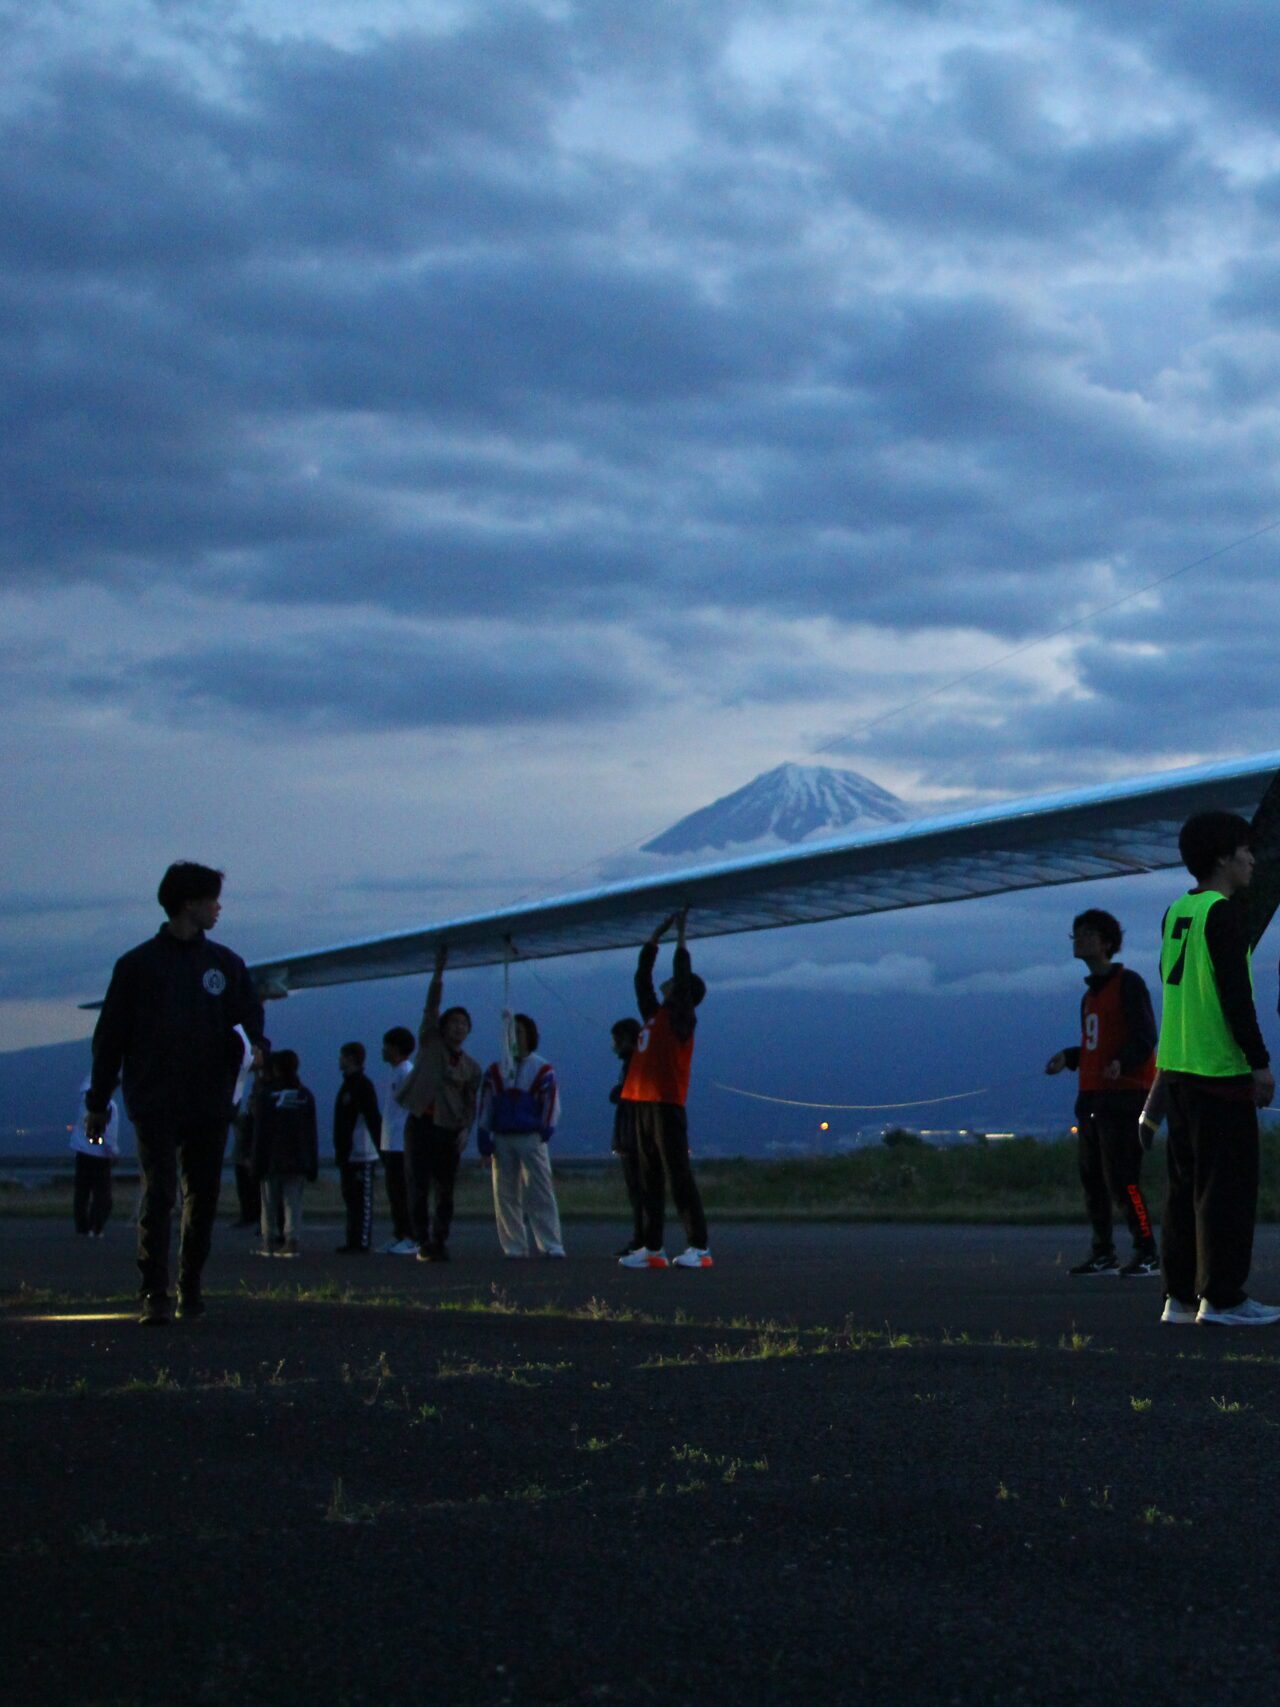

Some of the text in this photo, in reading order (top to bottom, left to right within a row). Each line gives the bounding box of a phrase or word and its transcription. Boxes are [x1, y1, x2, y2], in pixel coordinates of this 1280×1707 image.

[1166, 916, 1193, 985] 7
[1085, 1013, 1099, 1051] 9
[1126, 1184, 1152, 1239] UNDER
